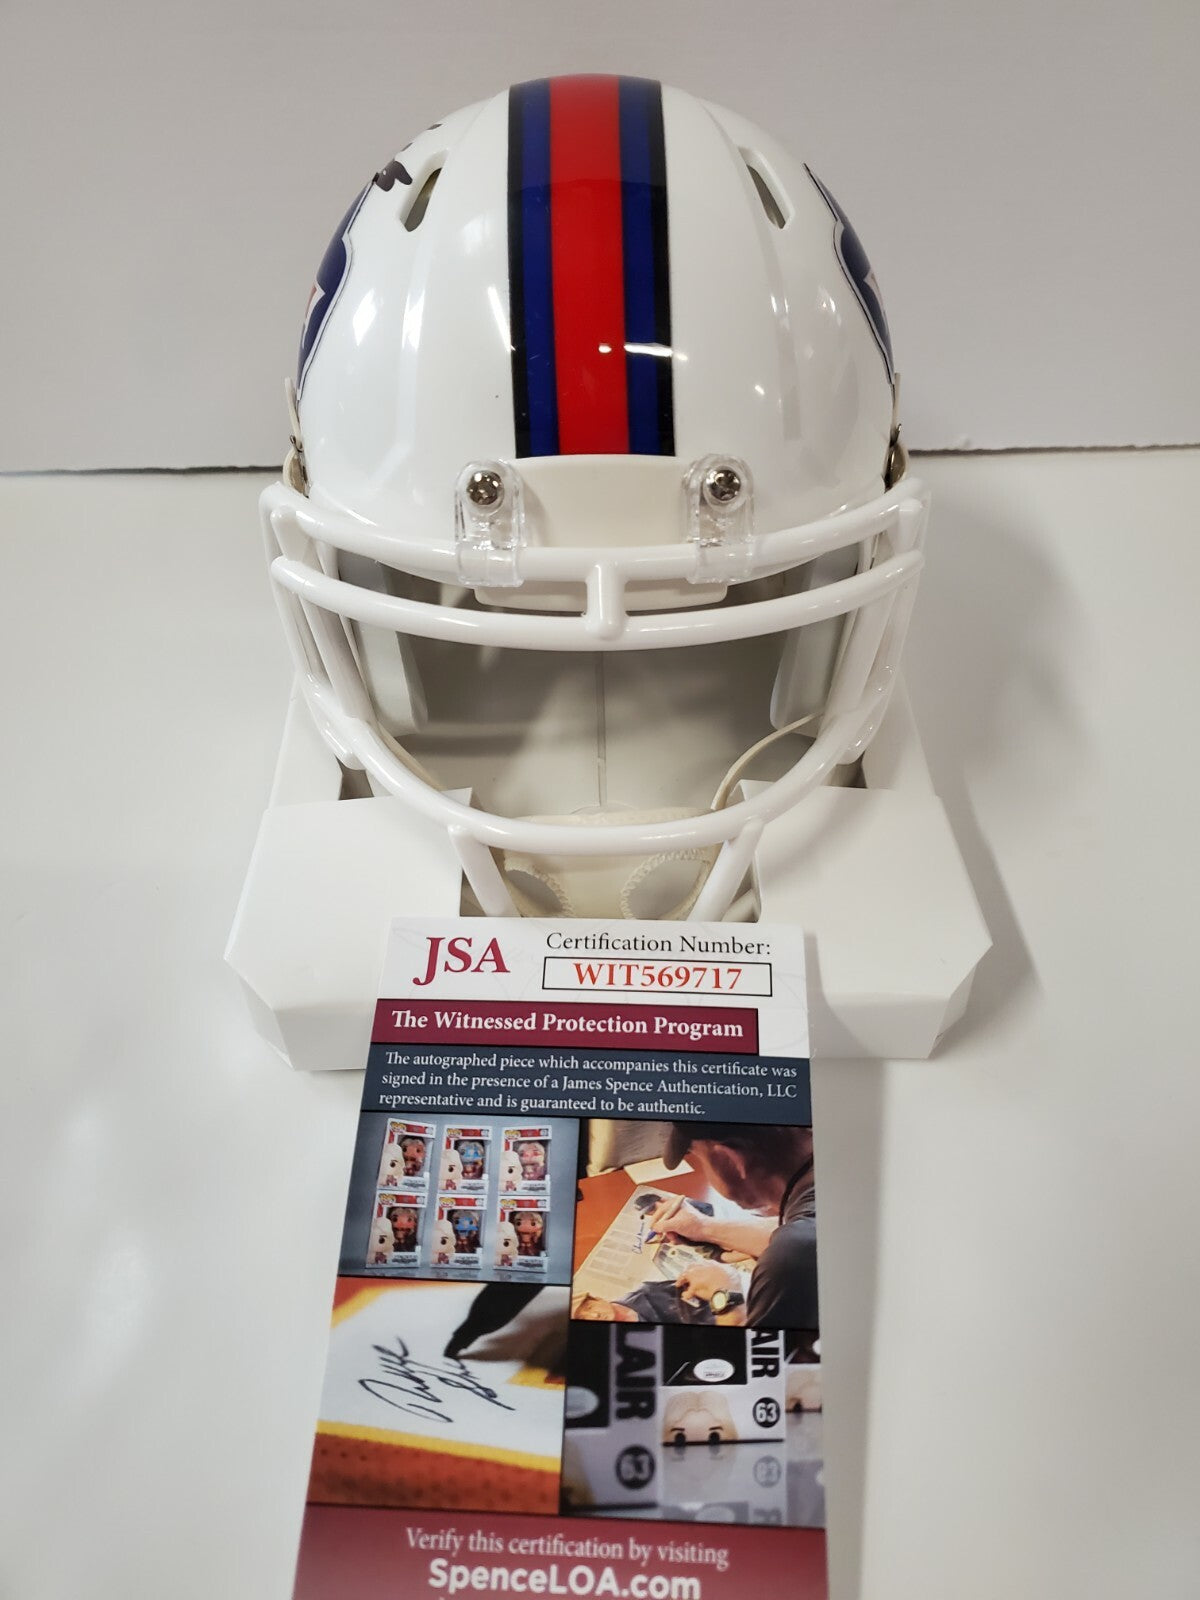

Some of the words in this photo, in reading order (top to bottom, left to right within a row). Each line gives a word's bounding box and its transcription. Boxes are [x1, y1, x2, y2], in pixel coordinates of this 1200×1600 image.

[546, 932, 672, 951] Certification
[680, 935, 771, 955] Number:
[412, 937, 511, 986] JSA
[573, 963, 742, 989] WIT569717
[392, 1010, 428, 1028] The
[434, 1011, 536, 1030] Witnessed
[542, 1013, 648, 1034] Protection
[653, 1016, 744, 1040] Program
[386, 1051, 410, 1065] The
[413, 1053, 497, 1069] autographed
[500, 1055, 535, 1070] piece
[539, 1055, 579, 1069] which
[583, 1059, 669, 1074] accompanies
[673, 1059, 698, 1073] this
[701, 1062, 768, 1076] certificate
[772, 1068, 797, 1077] was
[382, 1072, 425, 1088] signed
[429, 1072, 443, 1085] in
[447, 1073, 468, 1086] the
[471, 1076, 530, 1089] presence
[534, 1075, 550, 1088] of
[551, 1079, 559, 1089] a
[562, 1076, 602, 1091] James
[605, 1077, 653, 1094] Spence
[657, 1080, 763, 1098] Authentication,
[767, 1084, 797, 1098] LLC
[379, 1093, 474, 1109] representative
[477, 1094, 503, 1108] and
[507, 1095, 517, 1108] is
[520, 1097, 596, 1112] guaranteed
[600, 1099, 614, 1110] to
[617, 1098, 634, 1111] be
[637, 1100, 705, 1115] authentic.
[754, 1400, 779, 1425] 63
[406, 1527, 464, 1557] Verify
[468, 1530, 504, 1552] this
[508, 1534, 624, 1560] certification
[628, 1537, 651, 1567] by
[657, 1543, 729, 1570] visiting
[428, 1557, 701, 1600] SpenceLOA.com
